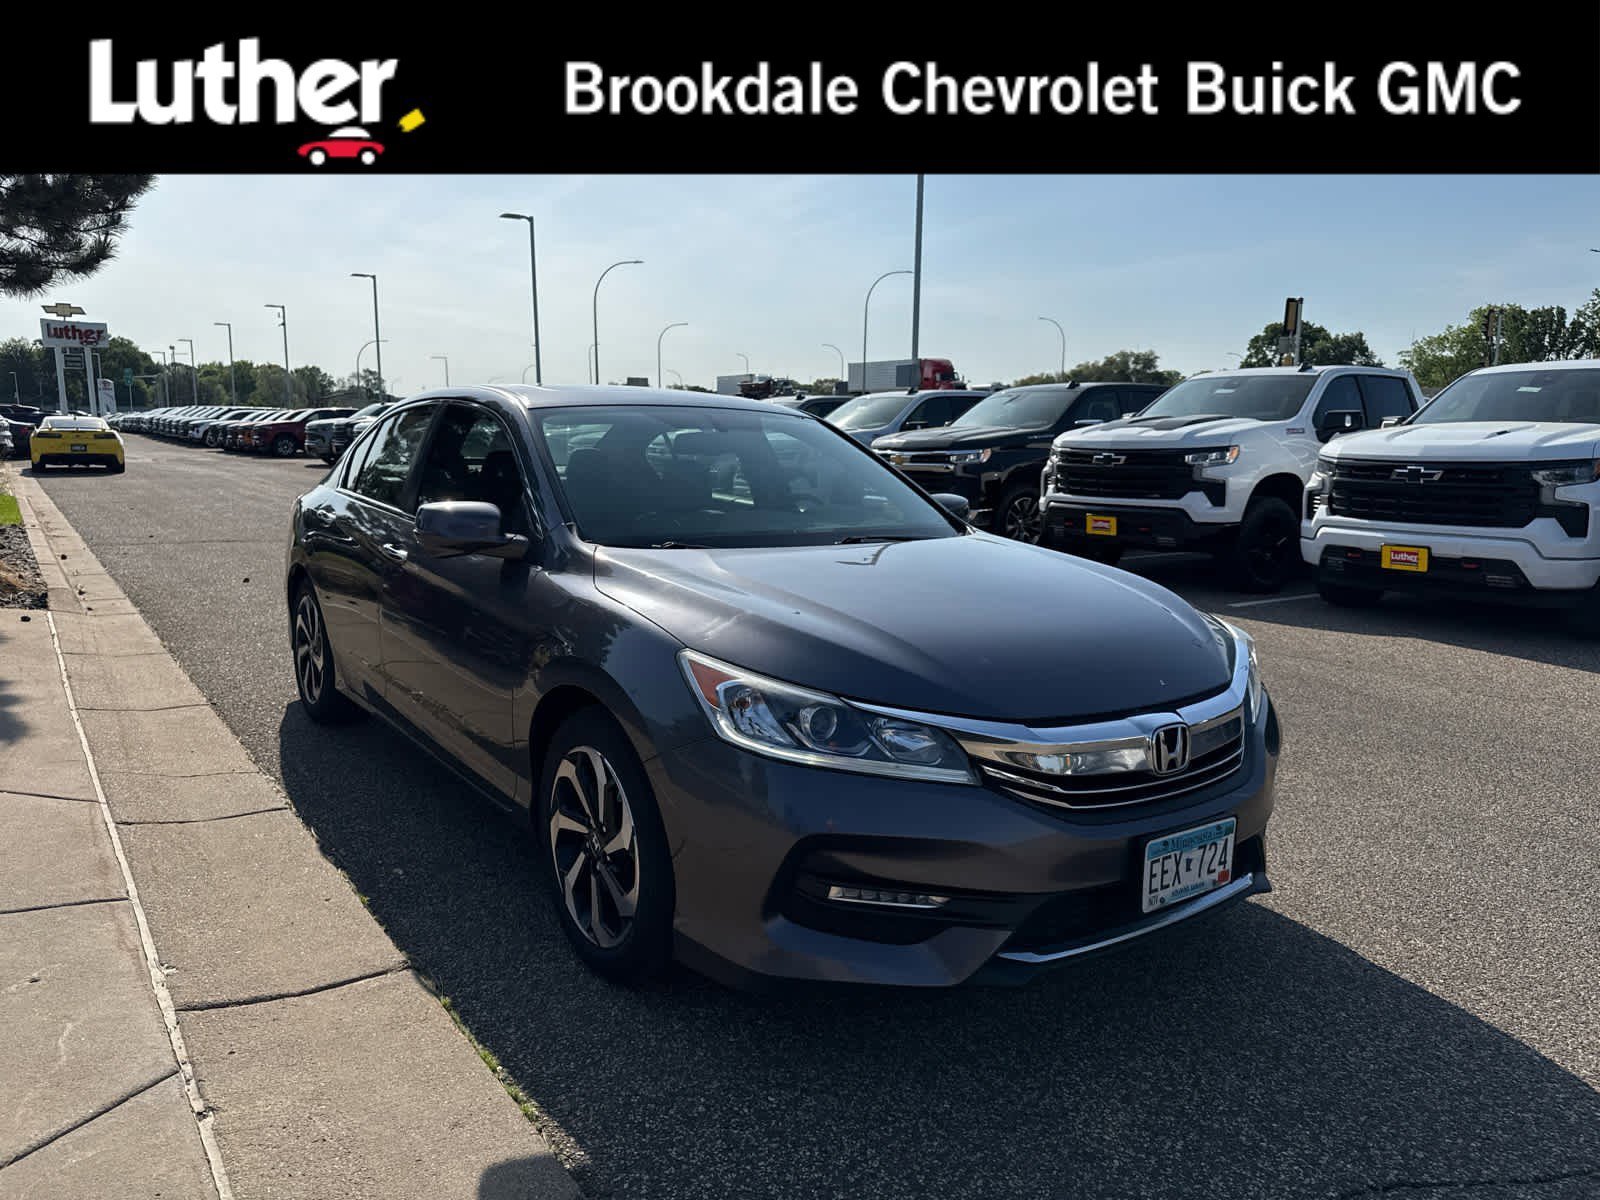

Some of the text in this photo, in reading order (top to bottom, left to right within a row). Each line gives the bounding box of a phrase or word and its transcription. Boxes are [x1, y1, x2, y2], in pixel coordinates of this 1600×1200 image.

[47, 322, 105, 341] Luther
[1148, 850, 1184, 895] EEX
[1197, 837, 1230, 879] 724
